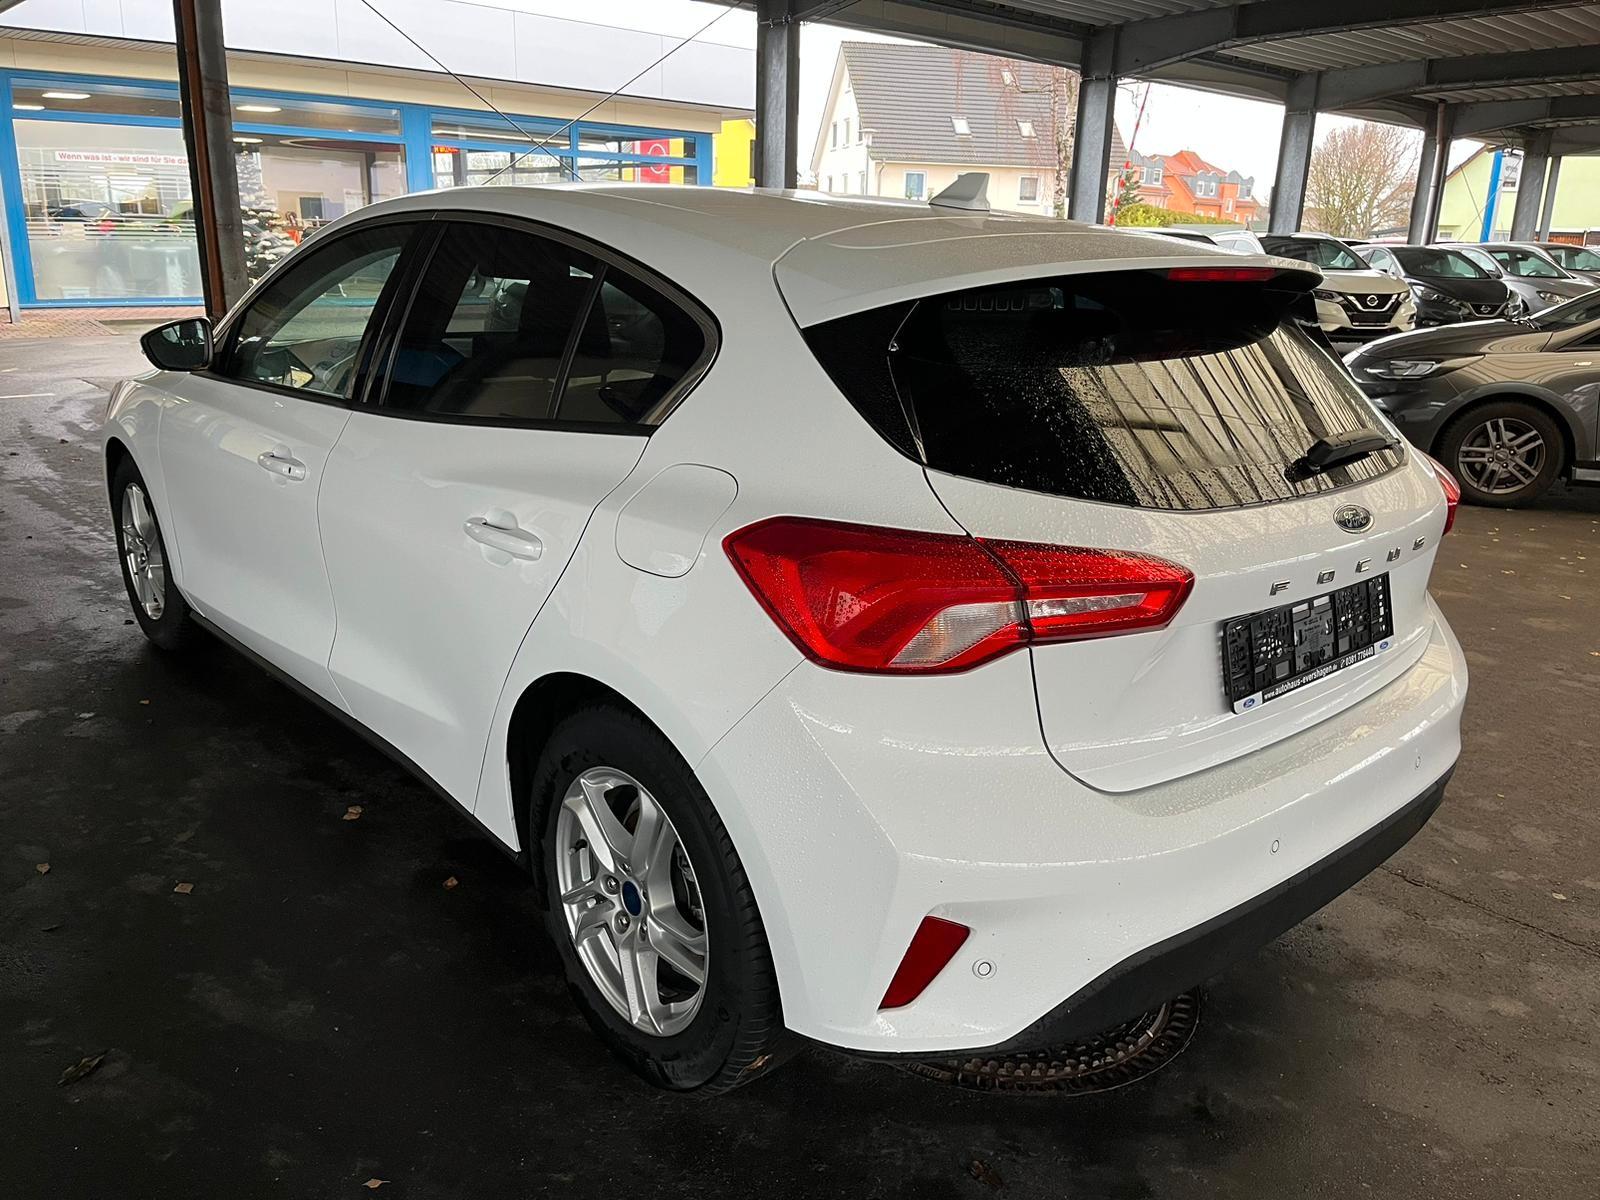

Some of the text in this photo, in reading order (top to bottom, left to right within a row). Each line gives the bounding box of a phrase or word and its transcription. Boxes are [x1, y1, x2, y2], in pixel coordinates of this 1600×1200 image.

[58, 152, 82, 160] Wenn
[83, 153, 100, 161] was
[101, 153, 112, 161] ist
[119, 154, 130, 162] wir
[132, 155, 149, 163] sind
[163, 156, 176, 164] Sie
[1270, 535, 1425, 596] FOCUS
[1264, 663, 1338, 700] www.autohaus-evershagen.de
[1345, 653, 1357, 666] 0381
